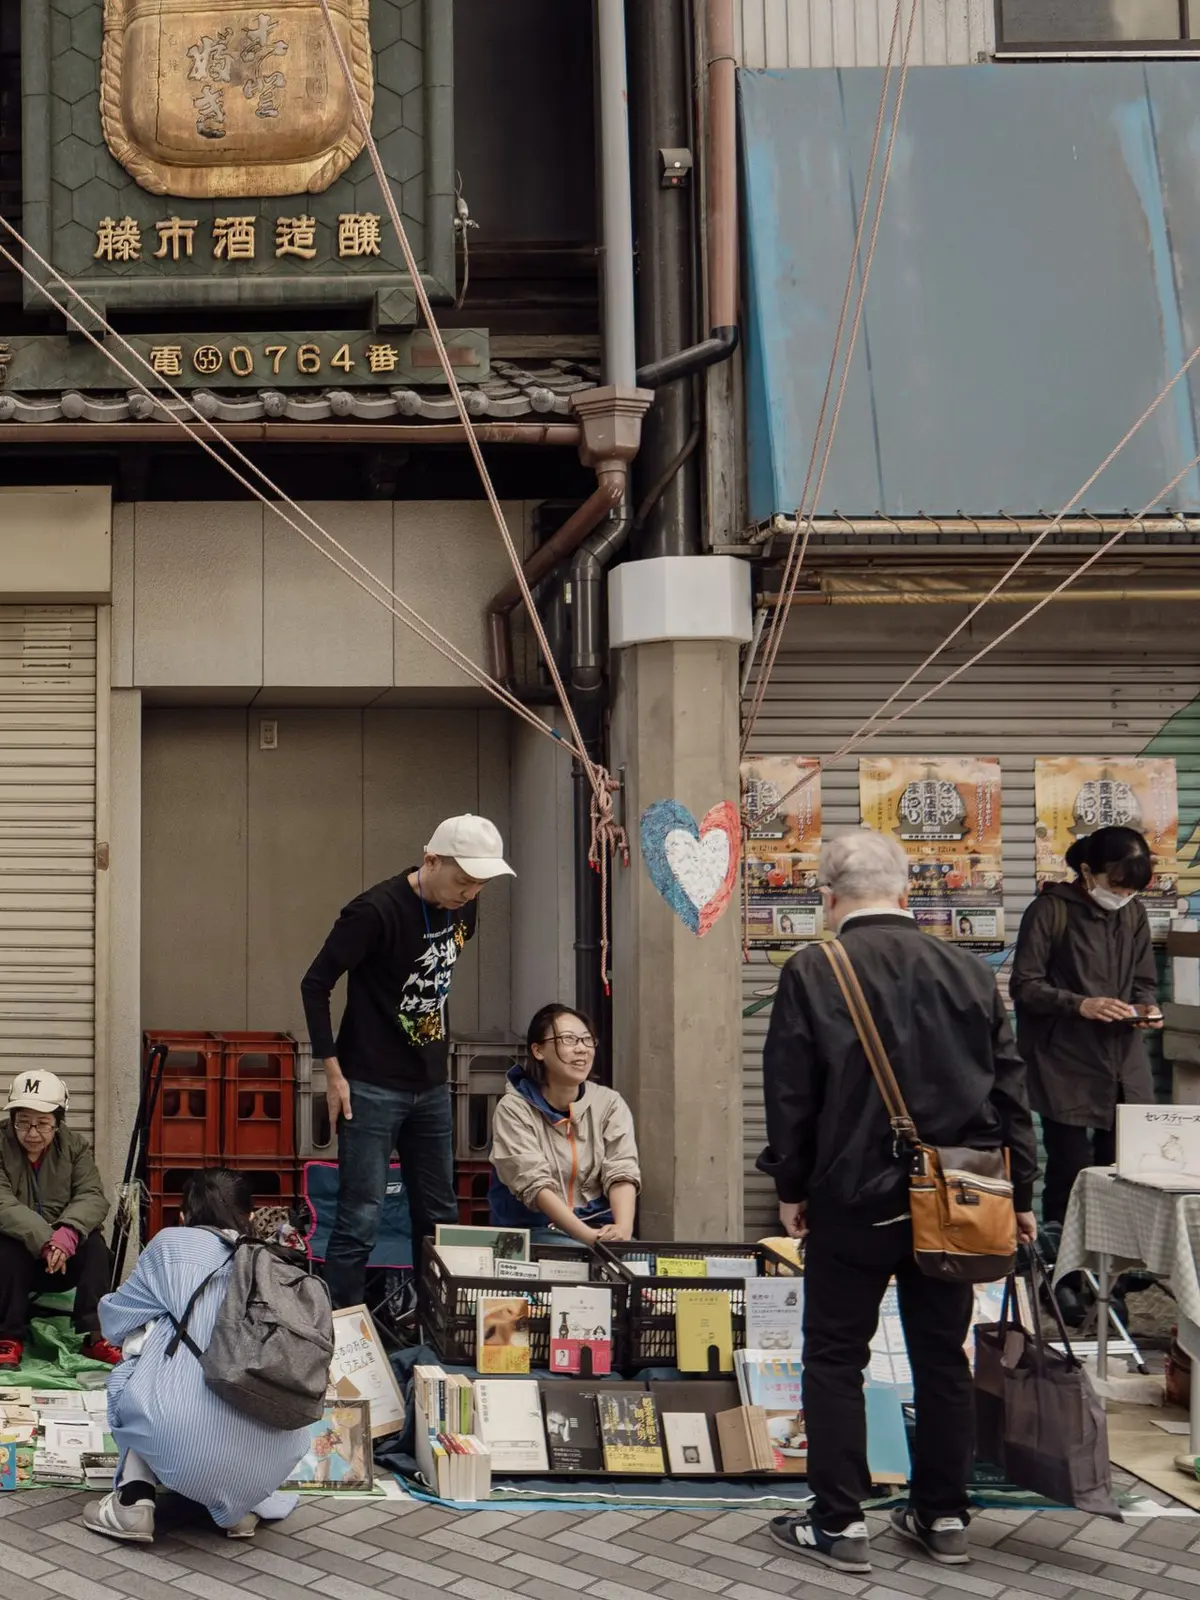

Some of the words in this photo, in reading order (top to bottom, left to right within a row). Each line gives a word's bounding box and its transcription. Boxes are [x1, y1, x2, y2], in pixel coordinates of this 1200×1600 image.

[905, 780, 921, 825] まつり
[922, 780, 939, 825] 商店街
[939, 780, 958, 825] なごや
[1083, 780, 1097, 825] まつり
[23, 1079, 40, 1094] M
